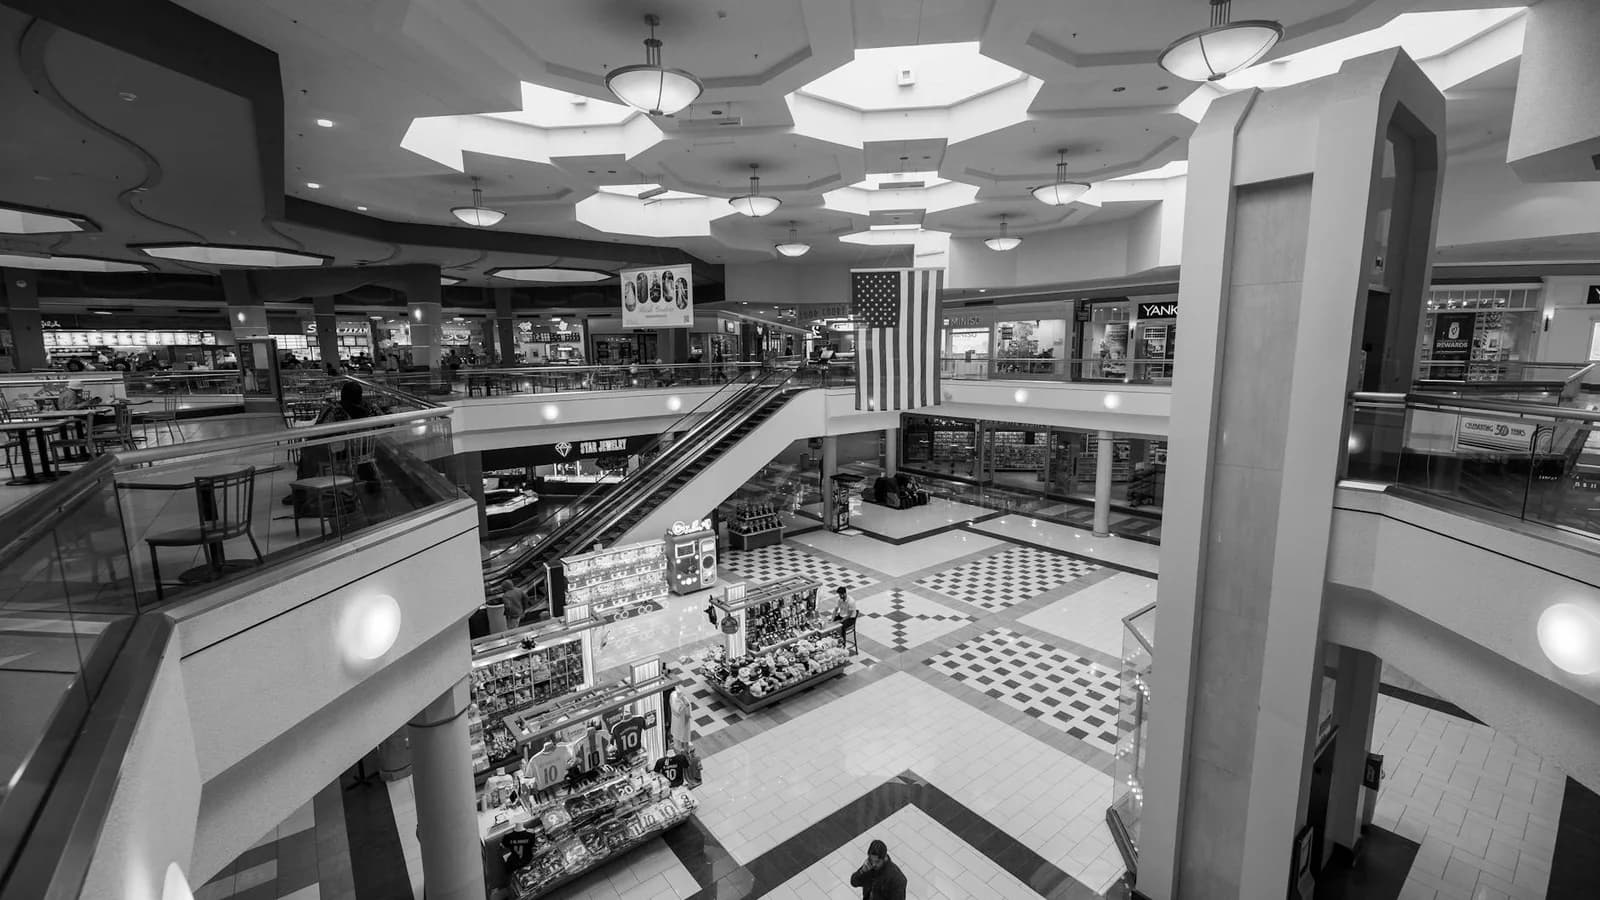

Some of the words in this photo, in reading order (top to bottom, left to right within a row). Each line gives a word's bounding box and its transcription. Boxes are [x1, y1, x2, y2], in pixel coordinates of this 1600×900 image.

[1494, 424, 1510, 437] 50
[581, 441, 598, 454] STAR
[598, 439, 627, 452] JEWELRY
[620, 731, 638, 751] 10
[588, 750, 601, 769] 10
[543, 764, 558, 785] 10
[665, 768, 677, 781] 10
[618, 785, 634, 797] 20
[659, 804, 676, 819] 10
[643, 815, 656, 828] 10
